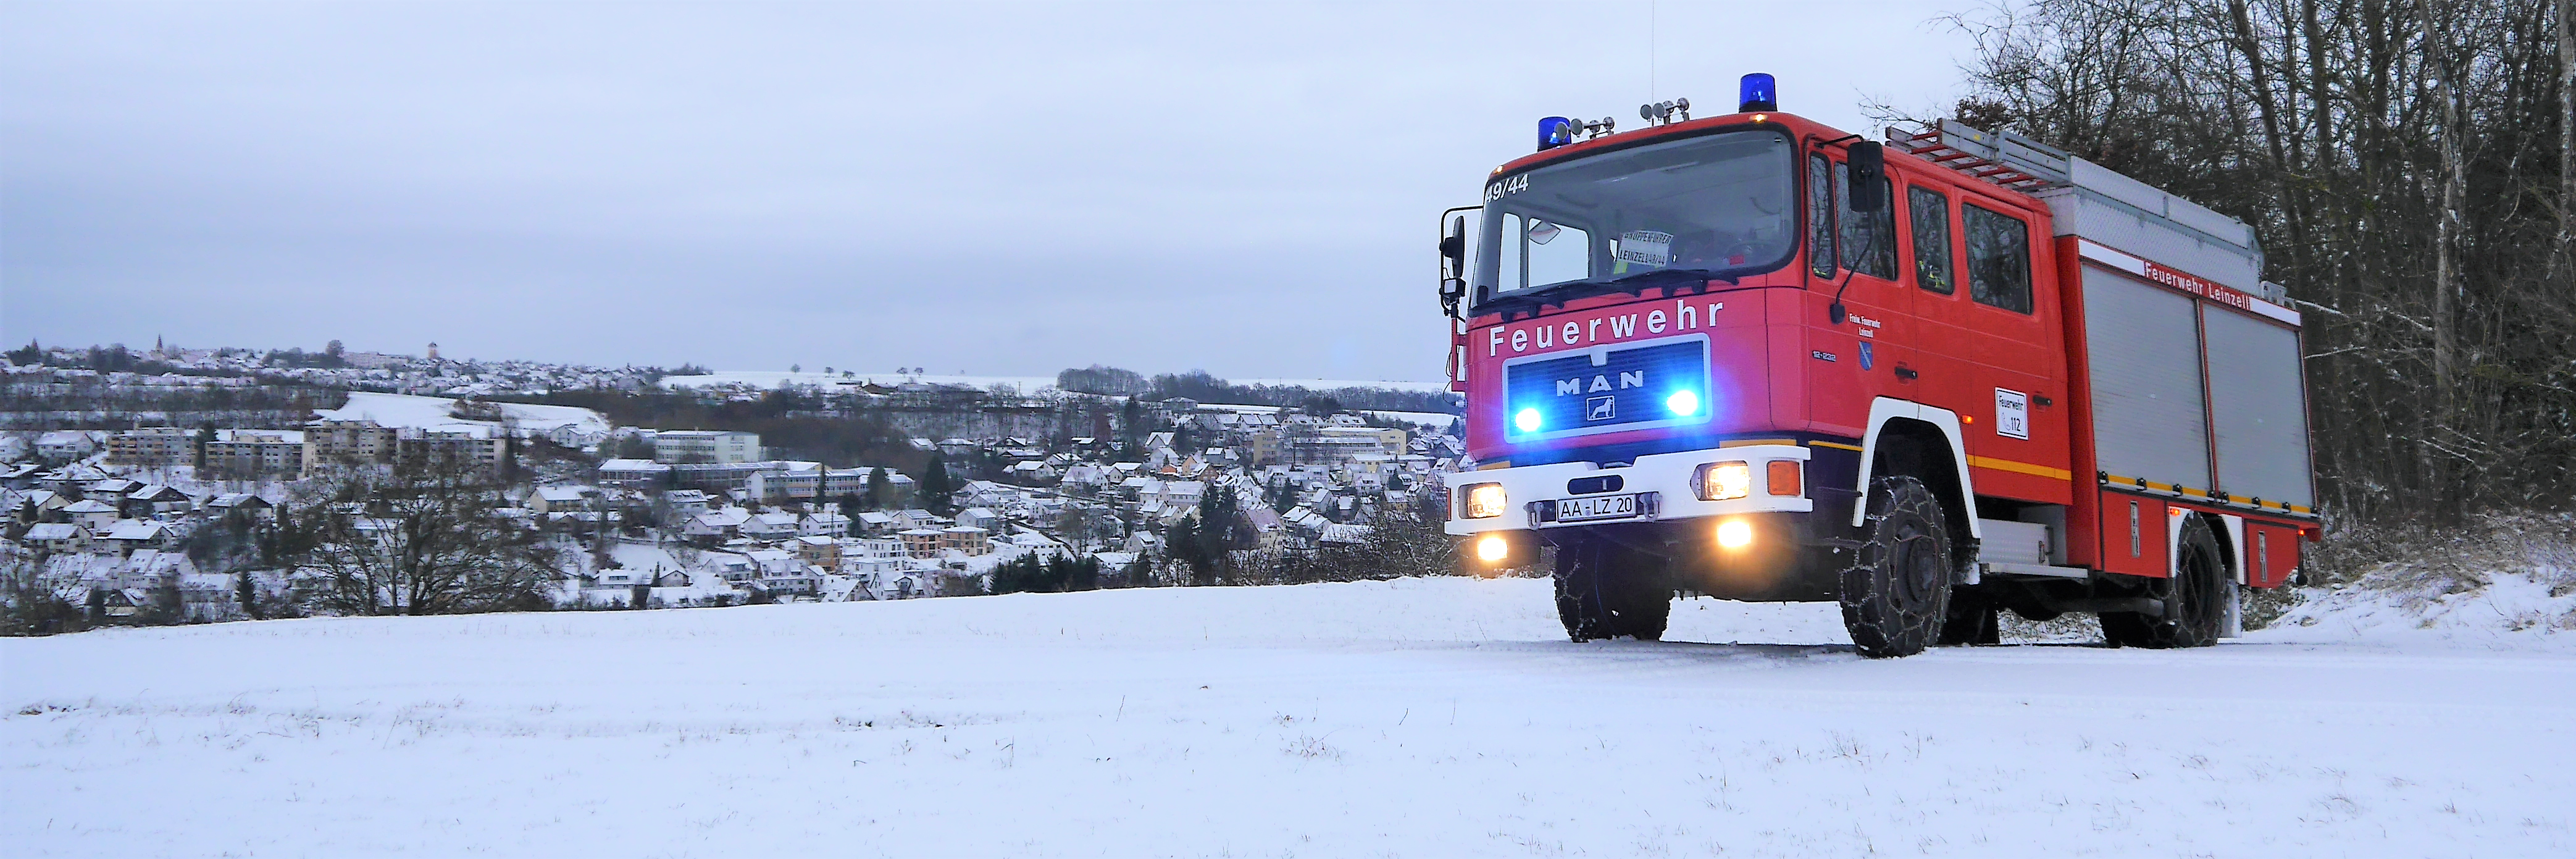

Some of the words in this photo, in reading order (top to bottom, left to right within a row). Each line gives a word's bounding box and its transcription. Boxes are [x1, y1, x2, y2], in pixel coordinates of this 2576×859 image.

[1485, 174, 1529, 203] 49/44
[2145, 262, 2204, 295] Feuerwehr
[2208, 282, 2250, 309] Leinzell
[1489, 299, 1723, 357] Feuerwehr
[1556, 370, 1644, 397] MAN
[1999, 395, 2023, 411] Feuerwehr
[2010, 417, 2021, 432] 112
